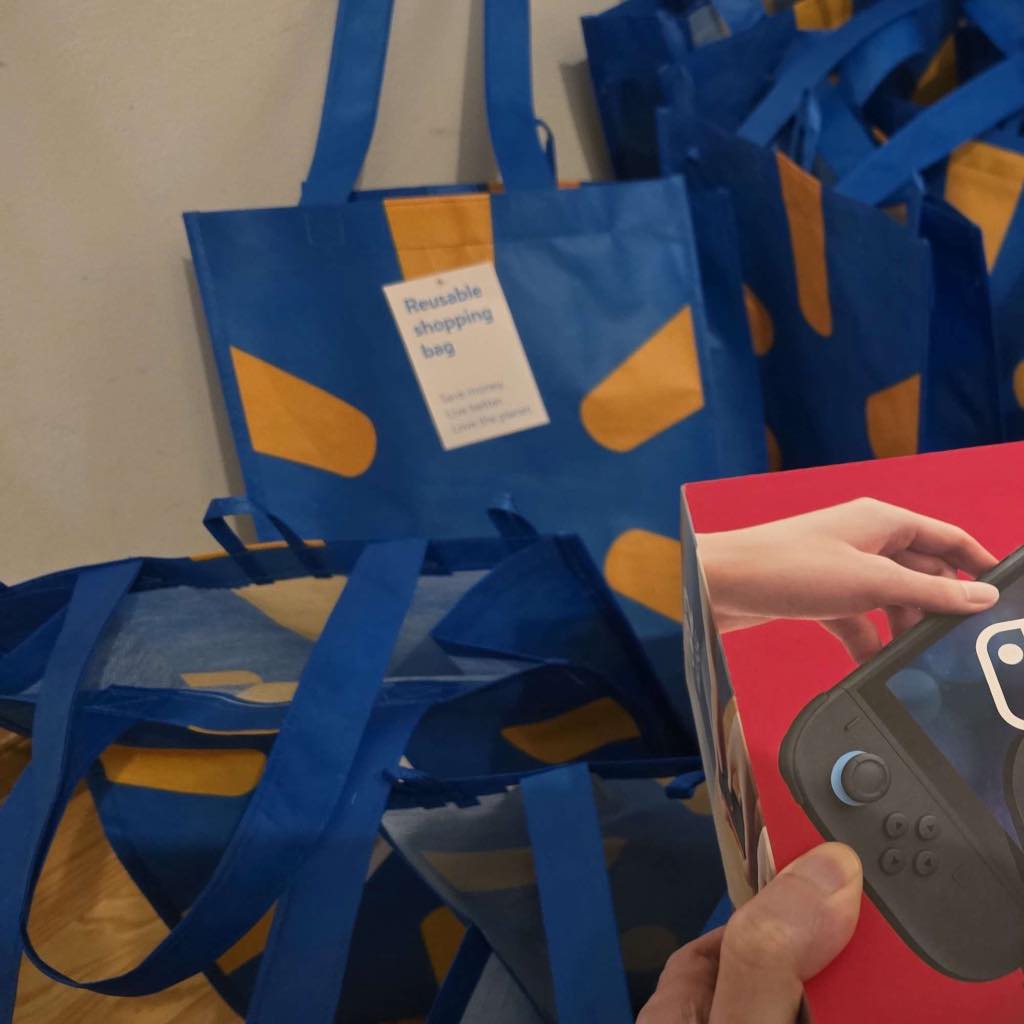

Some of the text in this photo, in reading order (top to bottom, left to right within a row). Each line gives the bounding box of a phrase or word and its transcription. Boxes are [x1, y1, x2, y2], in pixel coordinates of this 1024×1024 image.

[404, 286, 482, 313] Reusable
[414, 308, 494, 337] shopping
[421, 342, 456, 359] bag
